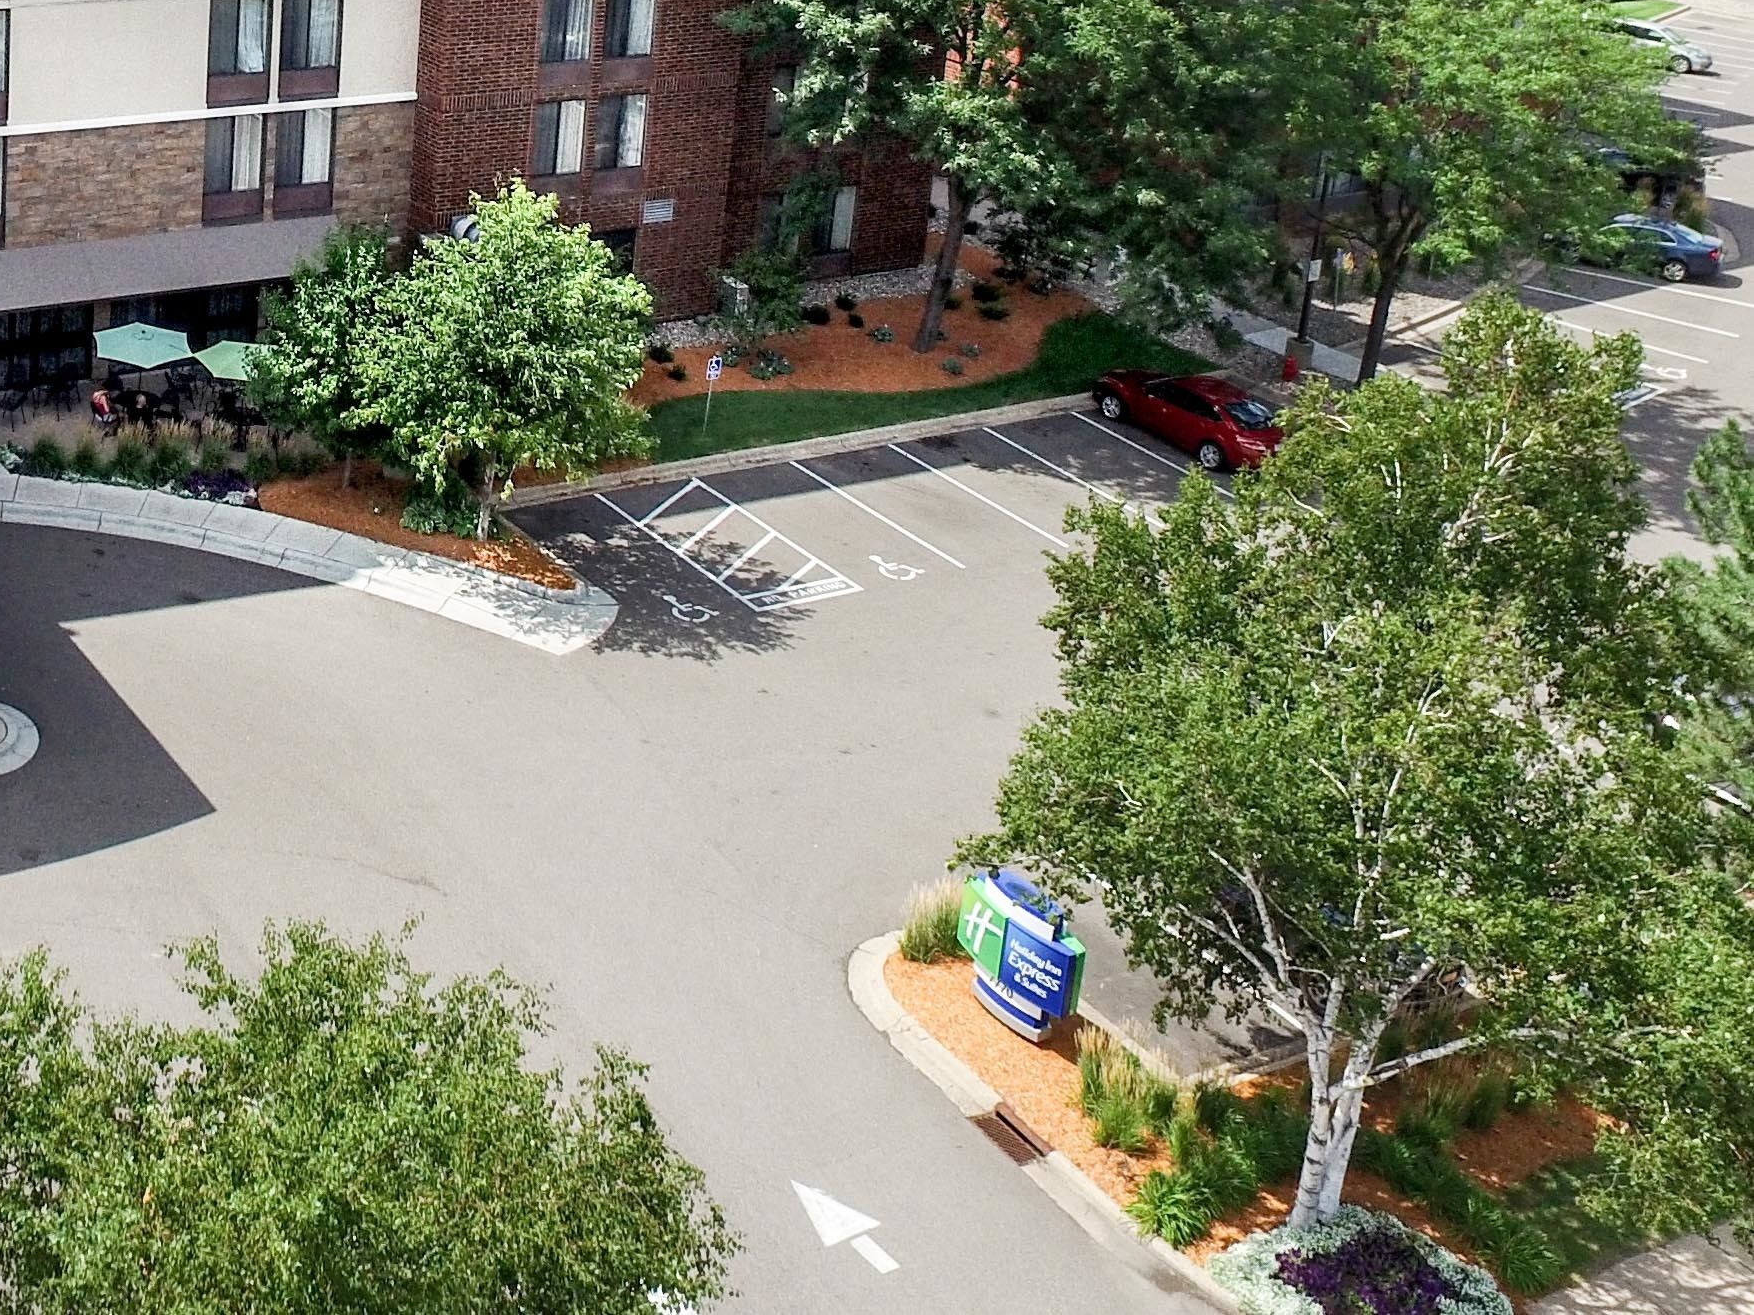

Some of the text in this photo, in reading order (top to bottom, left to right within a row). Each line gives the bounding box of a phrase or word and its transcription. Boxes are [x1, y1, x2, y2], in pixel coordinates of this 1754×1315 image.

[788, 581, 847, 599] PARKING
[1007, 951, 1062, 992] Express
[1010, 938, 1062, 977] Holiday Inn
[1021, 976, 1047, 999] Suites
